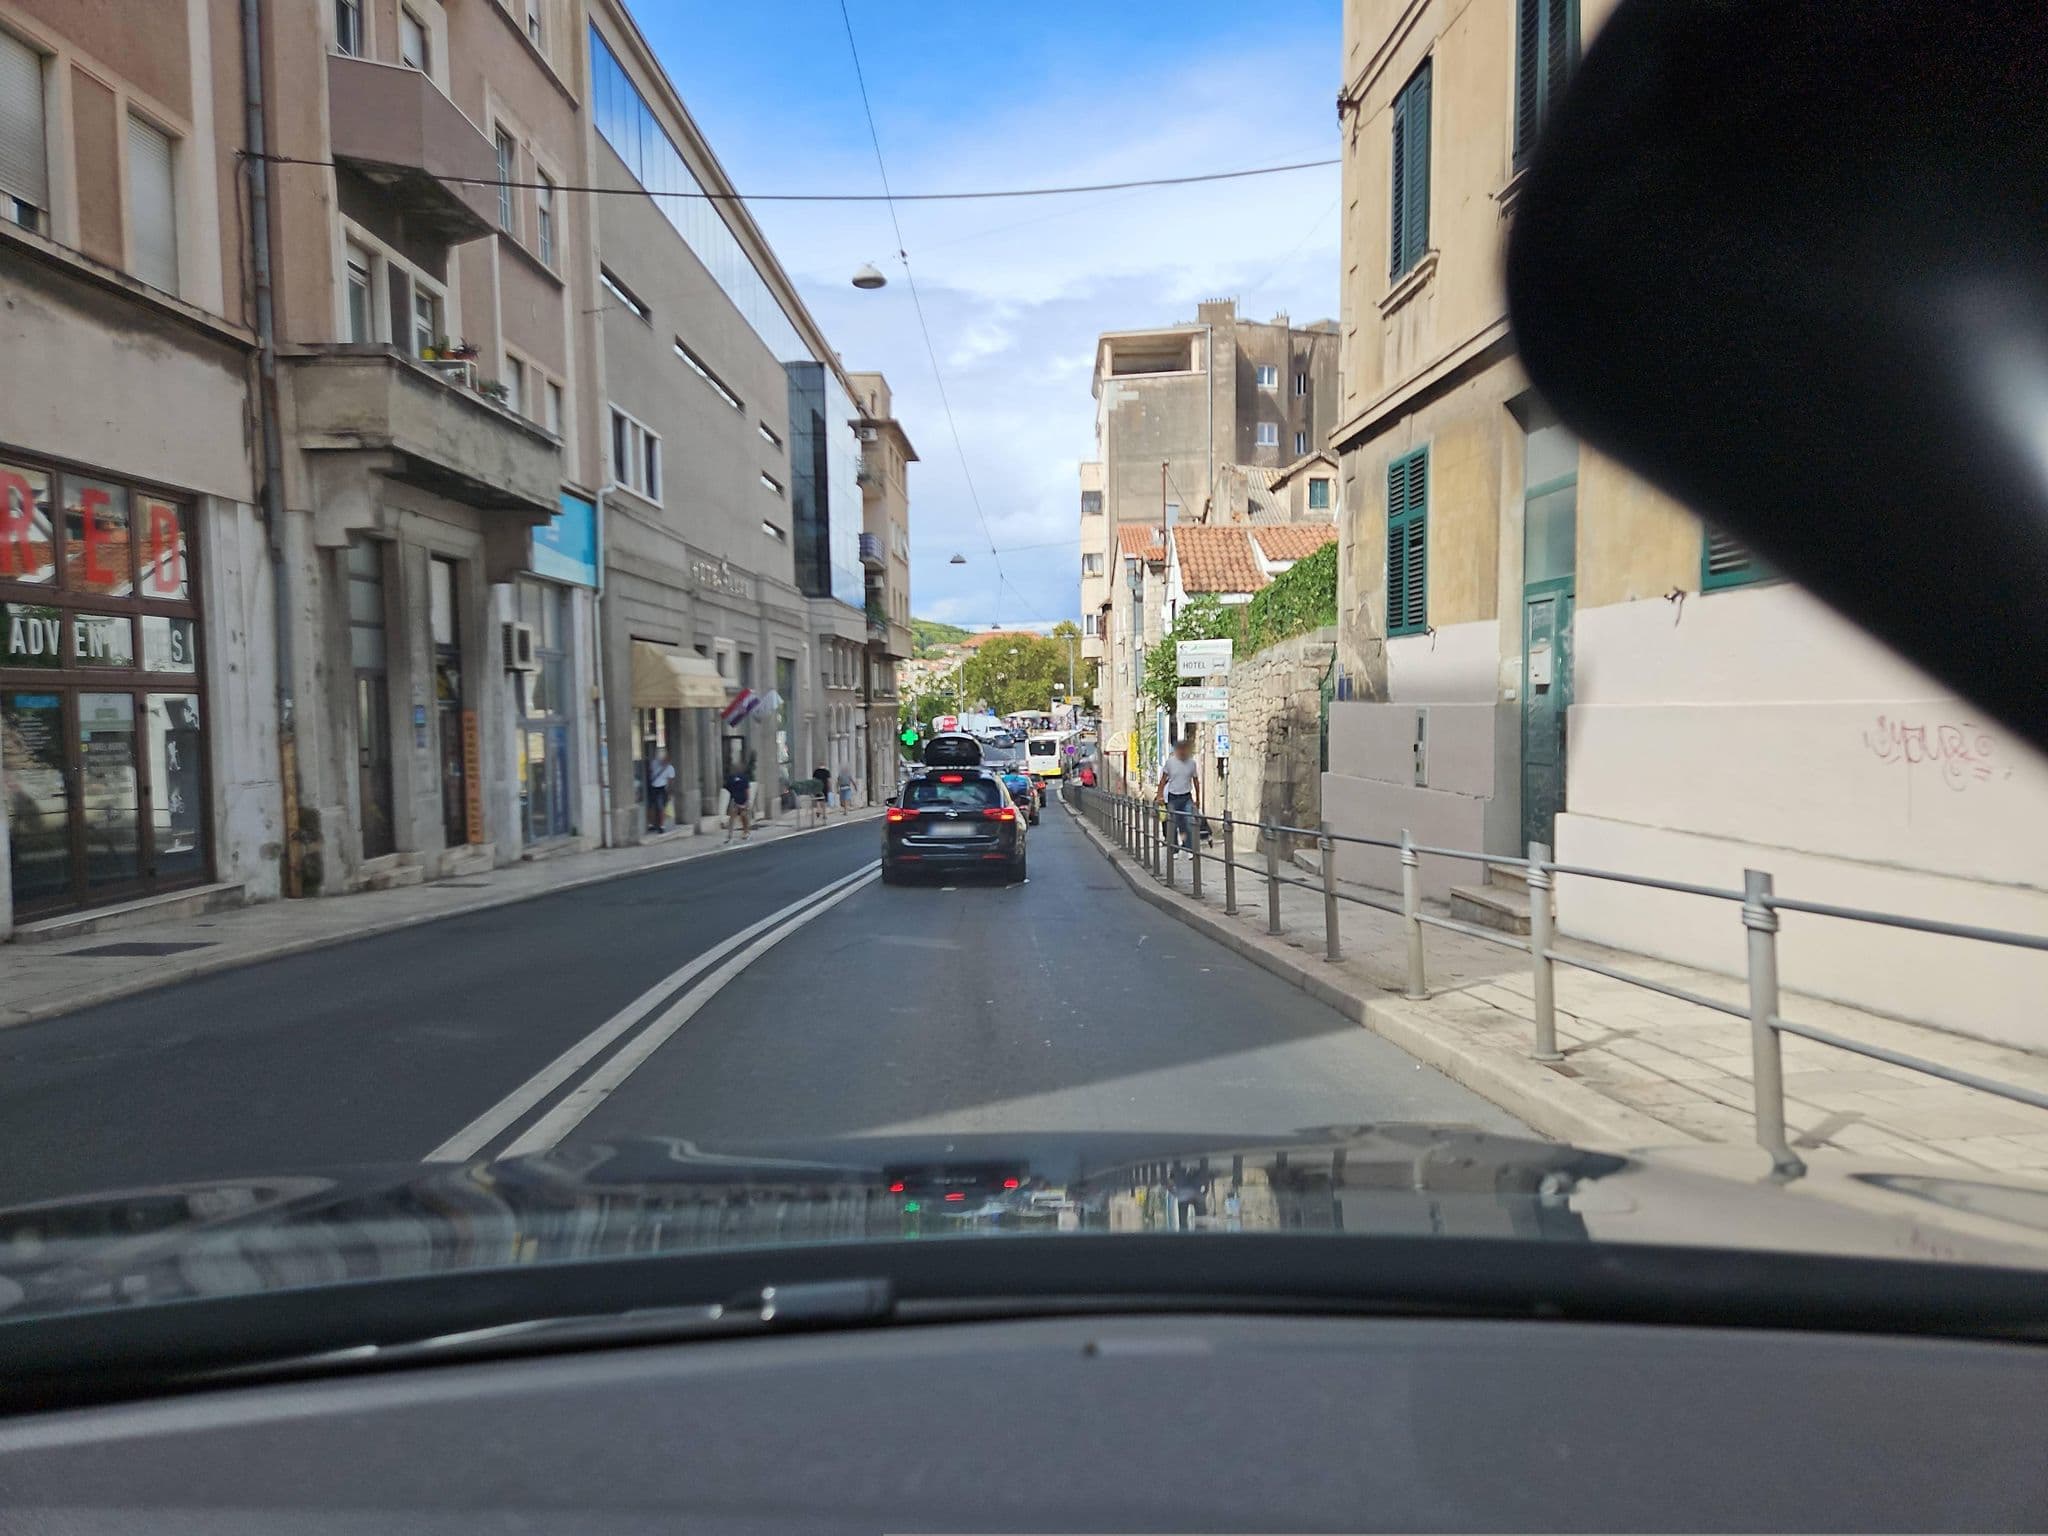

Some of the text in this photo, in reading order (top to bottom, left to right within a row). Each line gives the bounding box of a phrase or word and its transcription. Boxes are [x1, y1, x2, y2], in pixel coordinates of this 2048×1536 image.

[0, 471, 180, 592] RED
[10, 617, 183, 662] ADVENS
[1183, 661, 1206, 669] HOTEL
